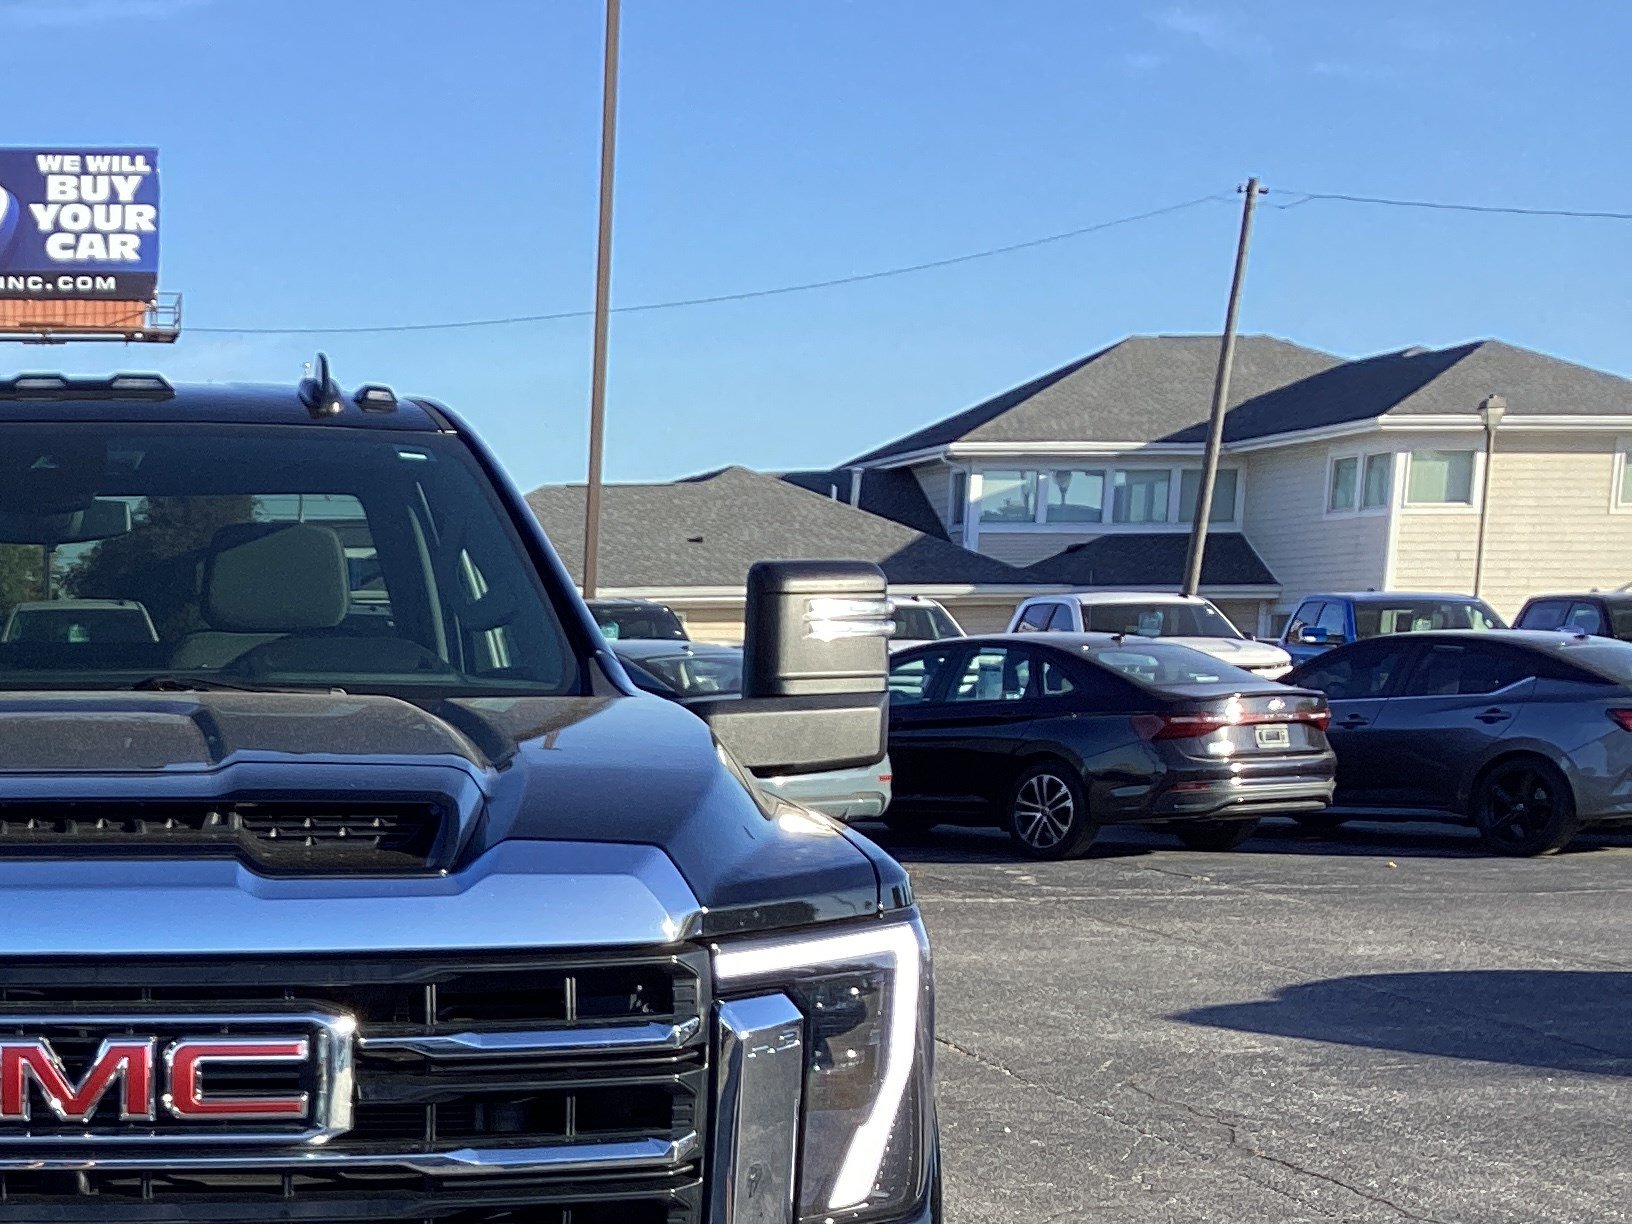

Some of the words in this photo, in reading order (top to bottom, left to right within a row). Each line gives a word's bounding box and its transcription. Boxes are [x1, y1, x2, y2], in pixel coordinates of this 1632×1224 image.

[36, 154, 81, 173] WE
[84, 154, 151, 173] WILL
[47, 174, 143, 202] BUY
[28, 203, 157, 232] YOUR
[46, 232, 142, 261] CAR
